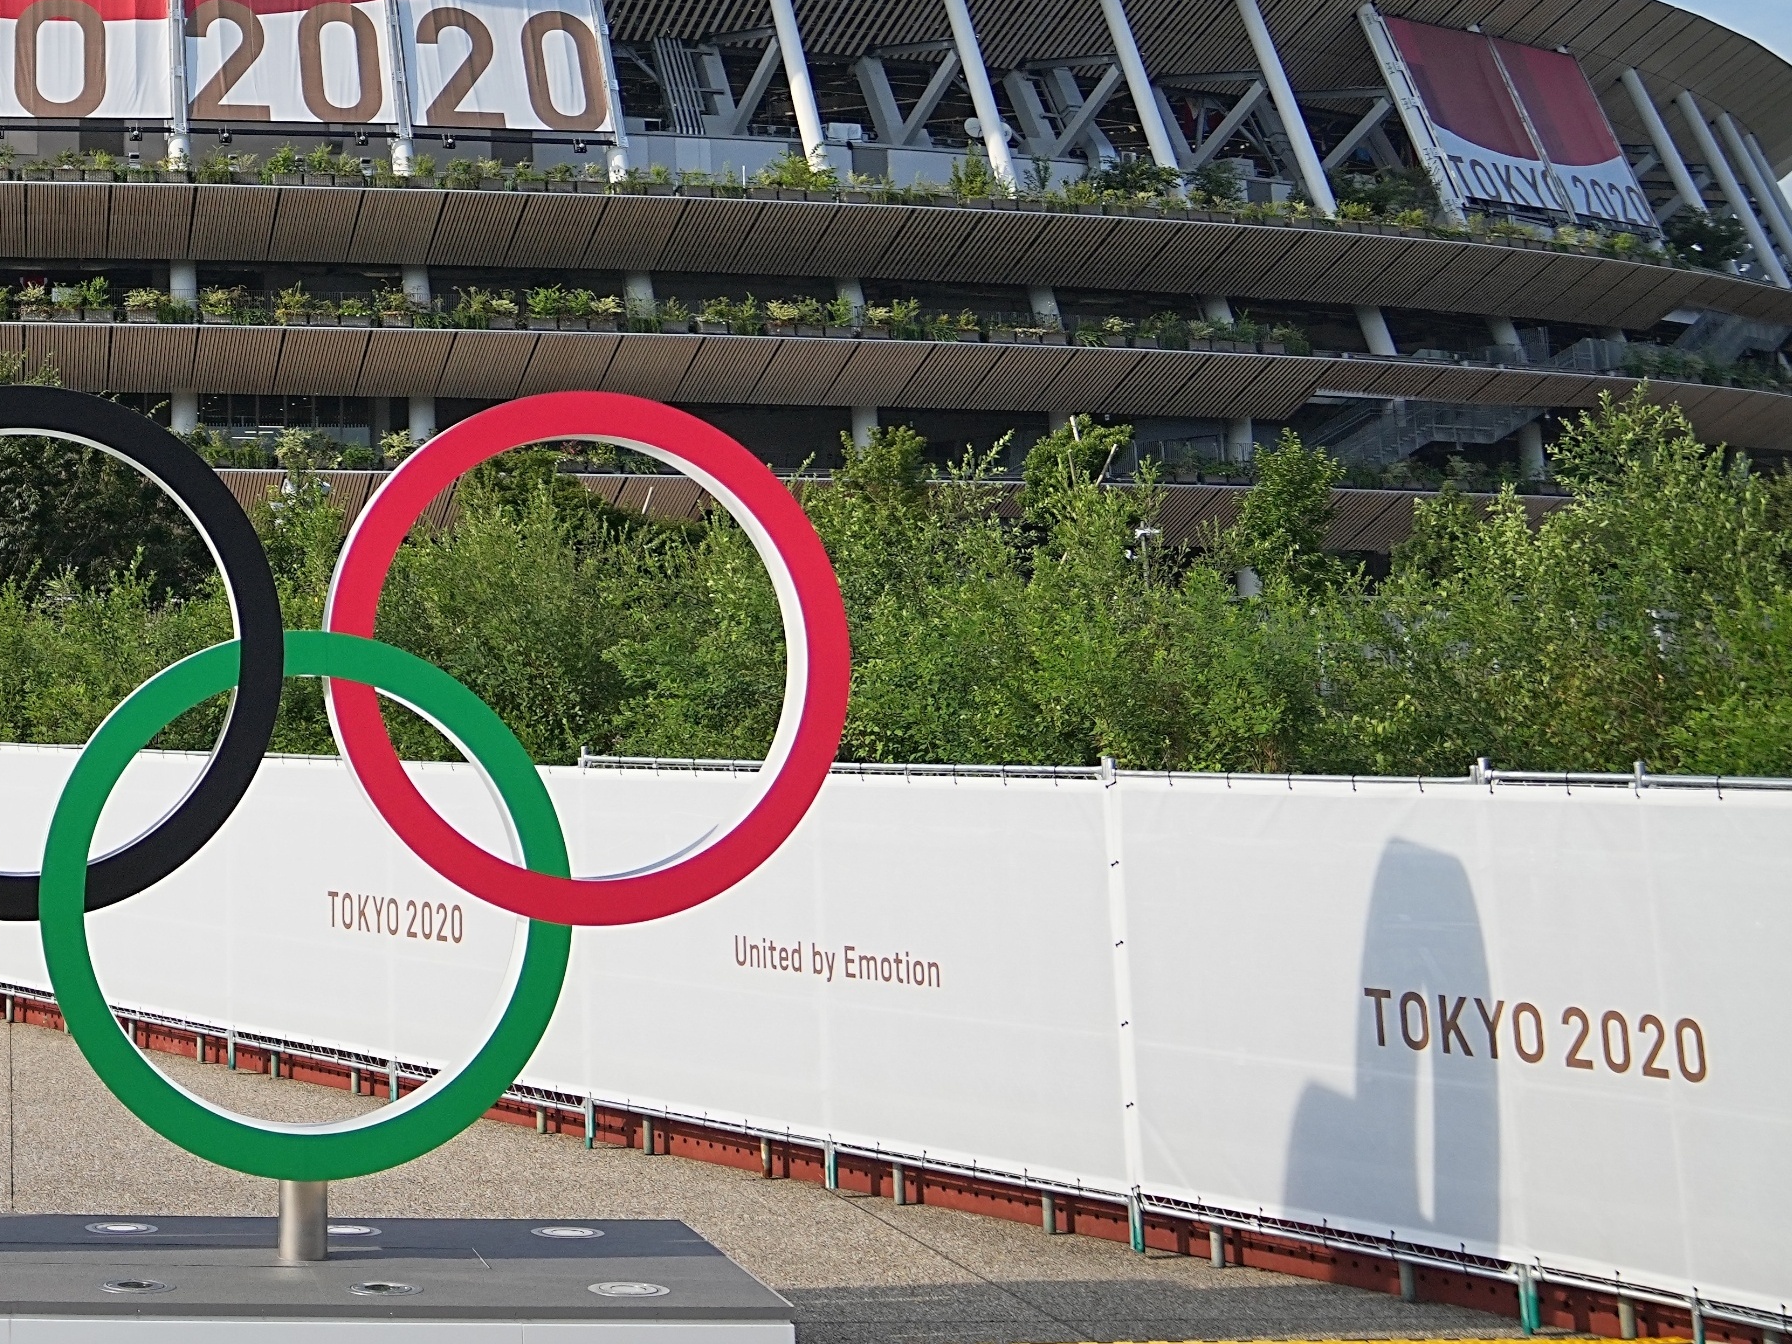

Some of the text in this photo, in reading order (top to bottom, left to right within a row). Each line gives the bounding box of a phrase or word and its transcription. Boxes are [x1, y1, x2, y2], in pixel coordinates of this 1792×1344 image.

[1447, 154, 1653, 226] TOKYO 2020
[327, 890, 463, 944] TOKYO 2020
[734, 934, 941, 988] United by Emotion
[1363, 987, 1708, 1084] TOKYO 2020
